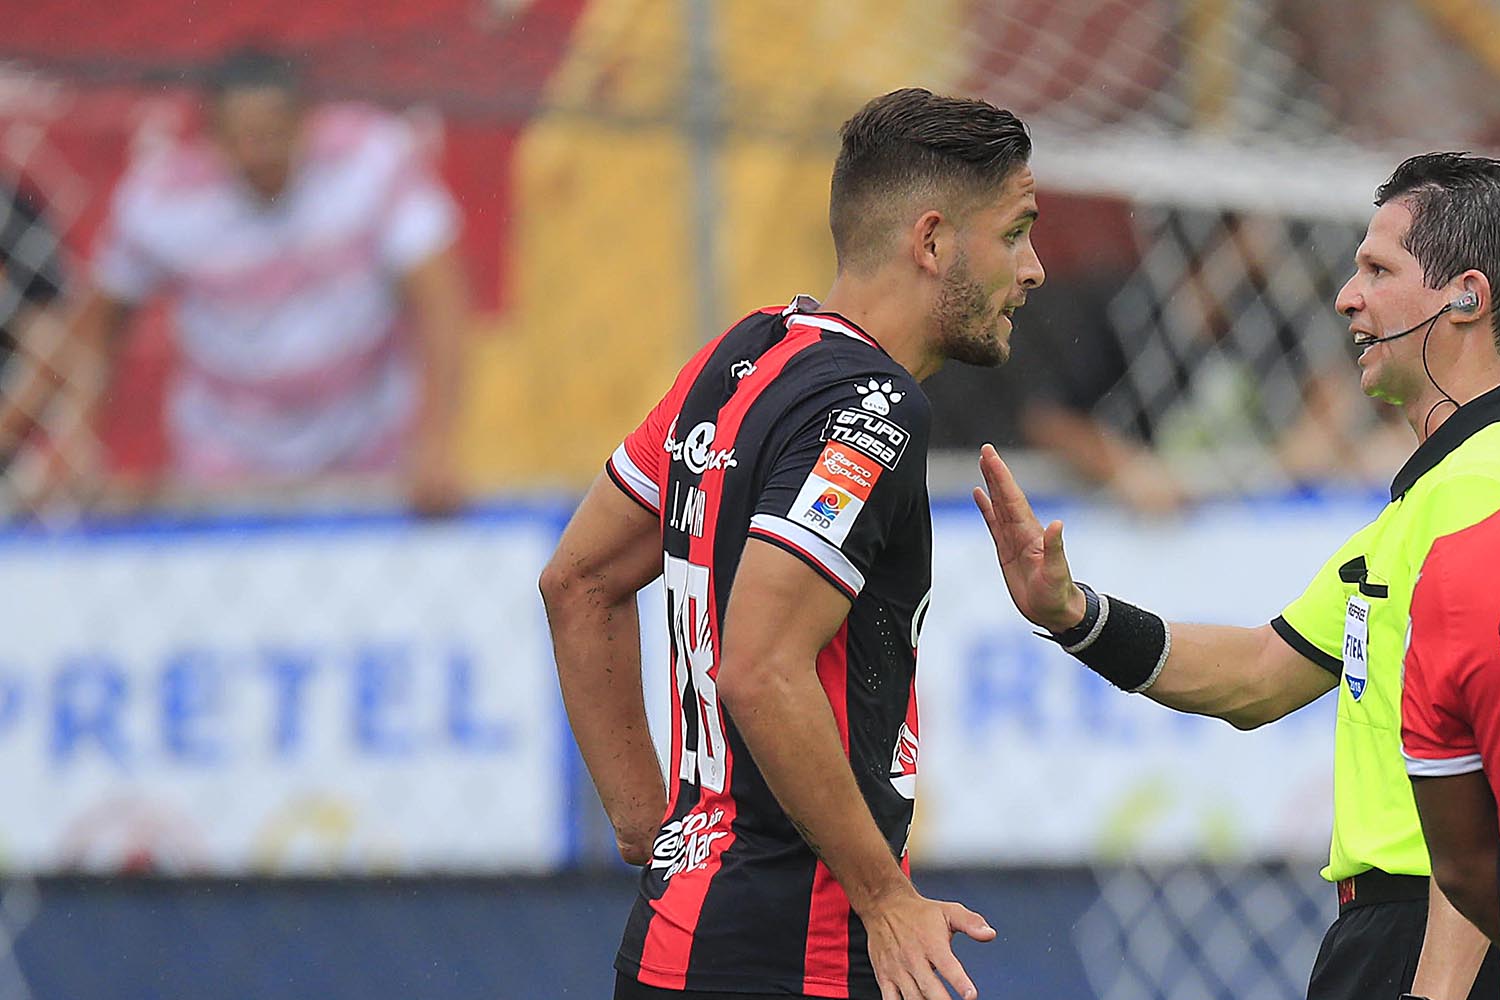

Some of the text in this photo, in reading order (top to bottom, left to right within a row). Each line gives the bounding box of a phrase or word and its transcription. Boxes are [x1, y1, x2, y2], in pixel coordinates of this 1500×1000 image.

[822, 459, 871, 488] Popular
[830, 452, 872, 479] Banco
[803, 509, 831, 530] FPD
[1345, 634, 1365, 662] FIFA
